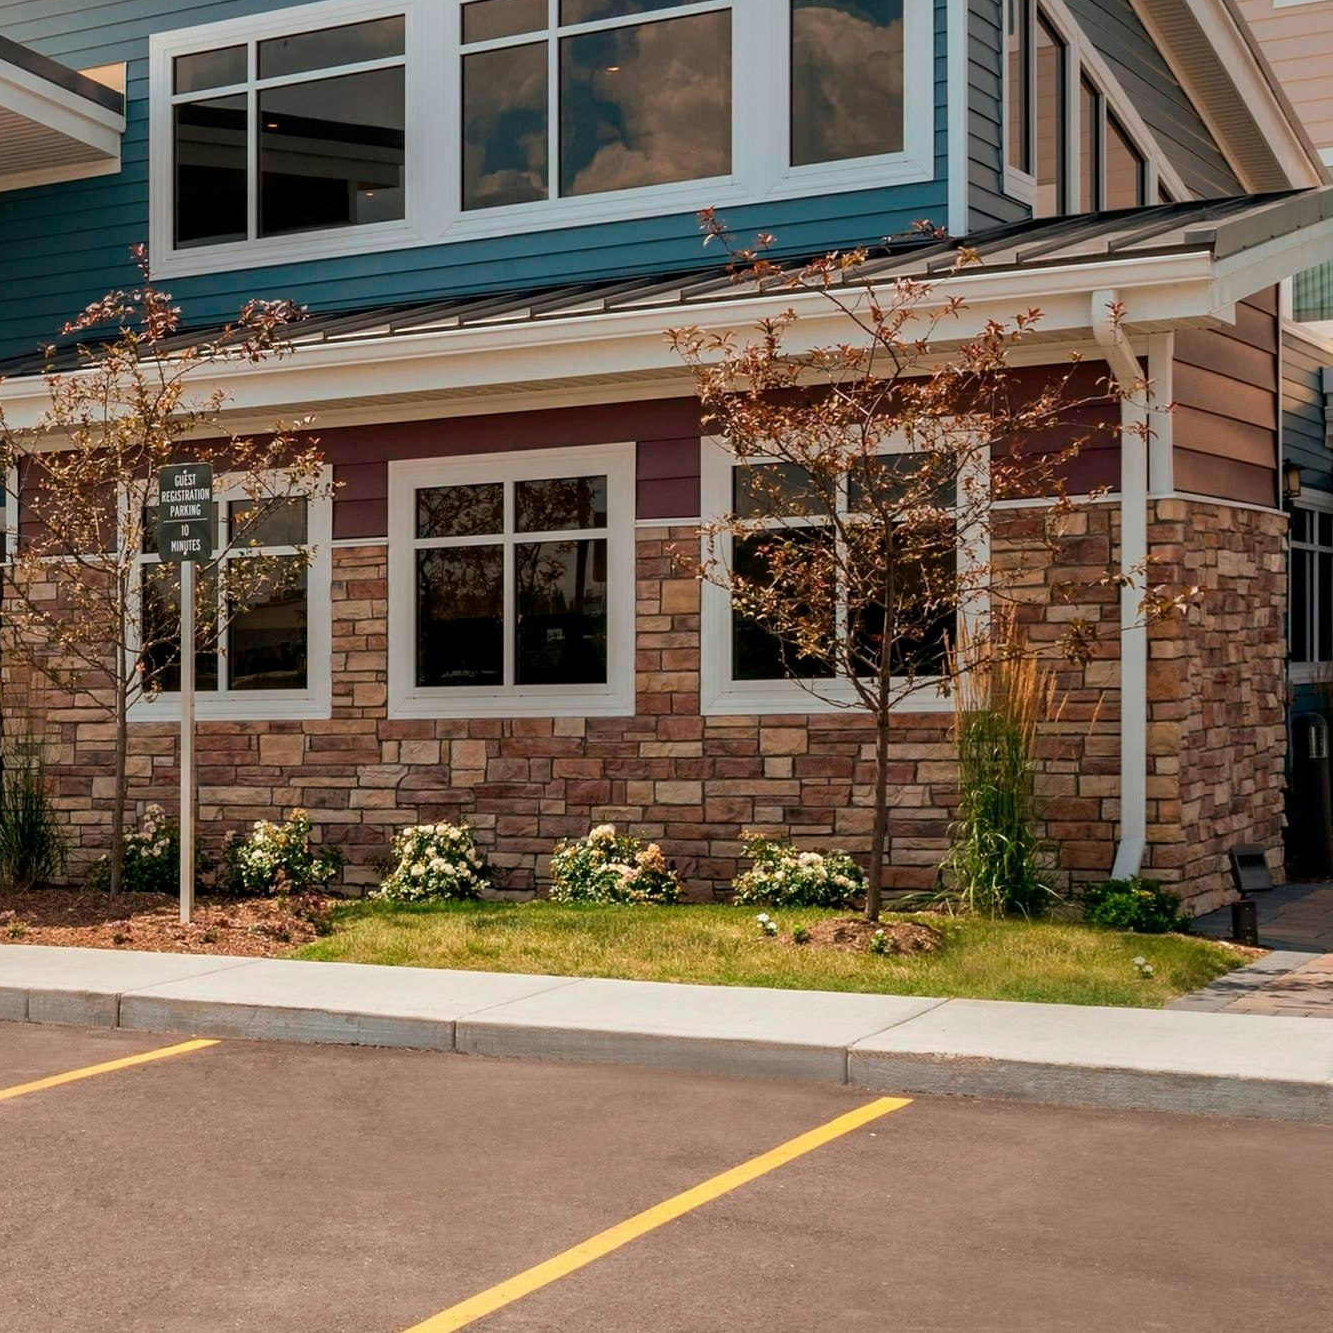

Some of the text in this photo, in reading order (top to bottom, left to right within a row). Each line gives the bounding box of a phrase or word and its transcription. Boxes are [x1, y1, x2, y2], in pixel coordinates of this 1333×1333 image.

[174, 474, 196, 487] GUEST
[161, 488, 210, 503] REGISTRATION
[170, 504, 201, 517] PARKING
[181, 524, 190, 537] 10
[170, 539, 201, 553] MINUTES
